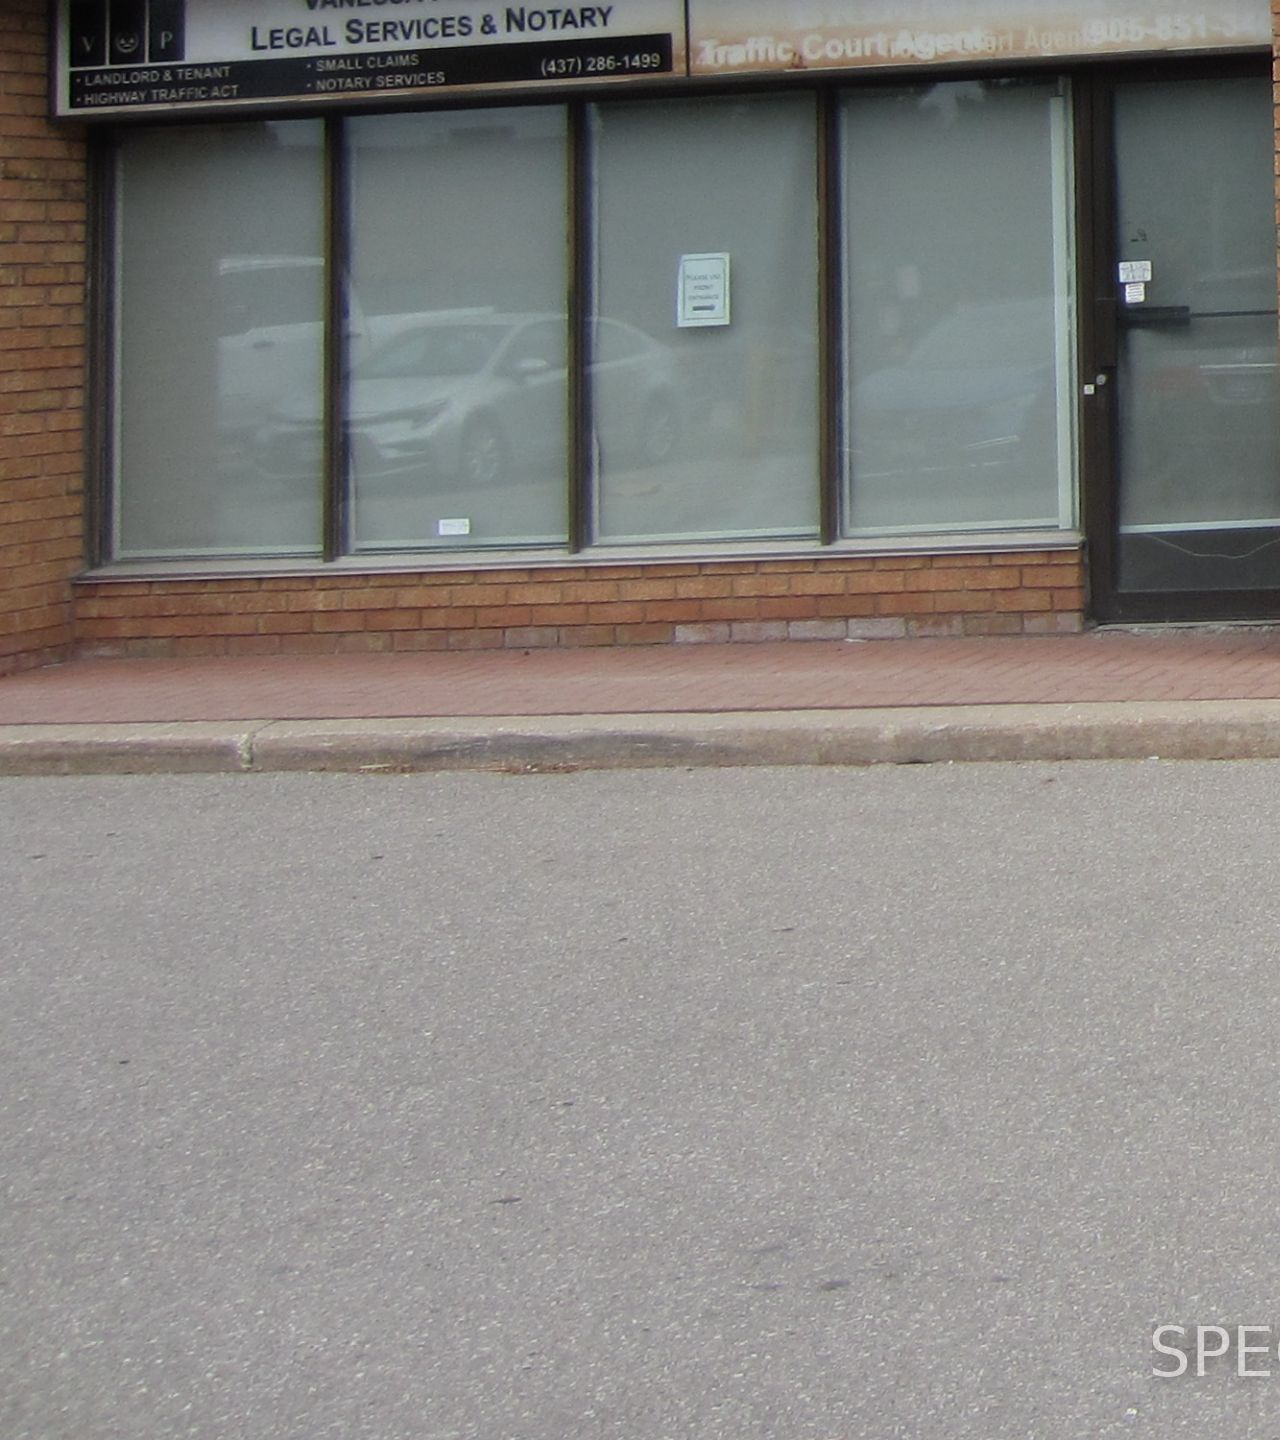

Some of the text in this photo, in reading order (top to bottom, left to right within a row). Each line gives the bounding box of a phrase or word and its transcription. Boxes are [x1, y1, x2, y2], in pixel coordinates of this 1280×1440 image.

[251, 6, 613, 51] LEGAL SERVICES & NOTARY
[160, 31, 173, 50] P
[699, 35, 795, 66] Traffic
[802, 32, 889, 60] Court
[315, 54, 420, 73] SMALL CLAIMS
[541, 53, 661, 77] (437) 286-1499
[84, 65, 232, 87] LANDLORD & TENANT
[315, 71, 445, 92] NOTARY SERVICES
[84, 83, 240, 106] HIGHWAY TRAFFIC ACT
